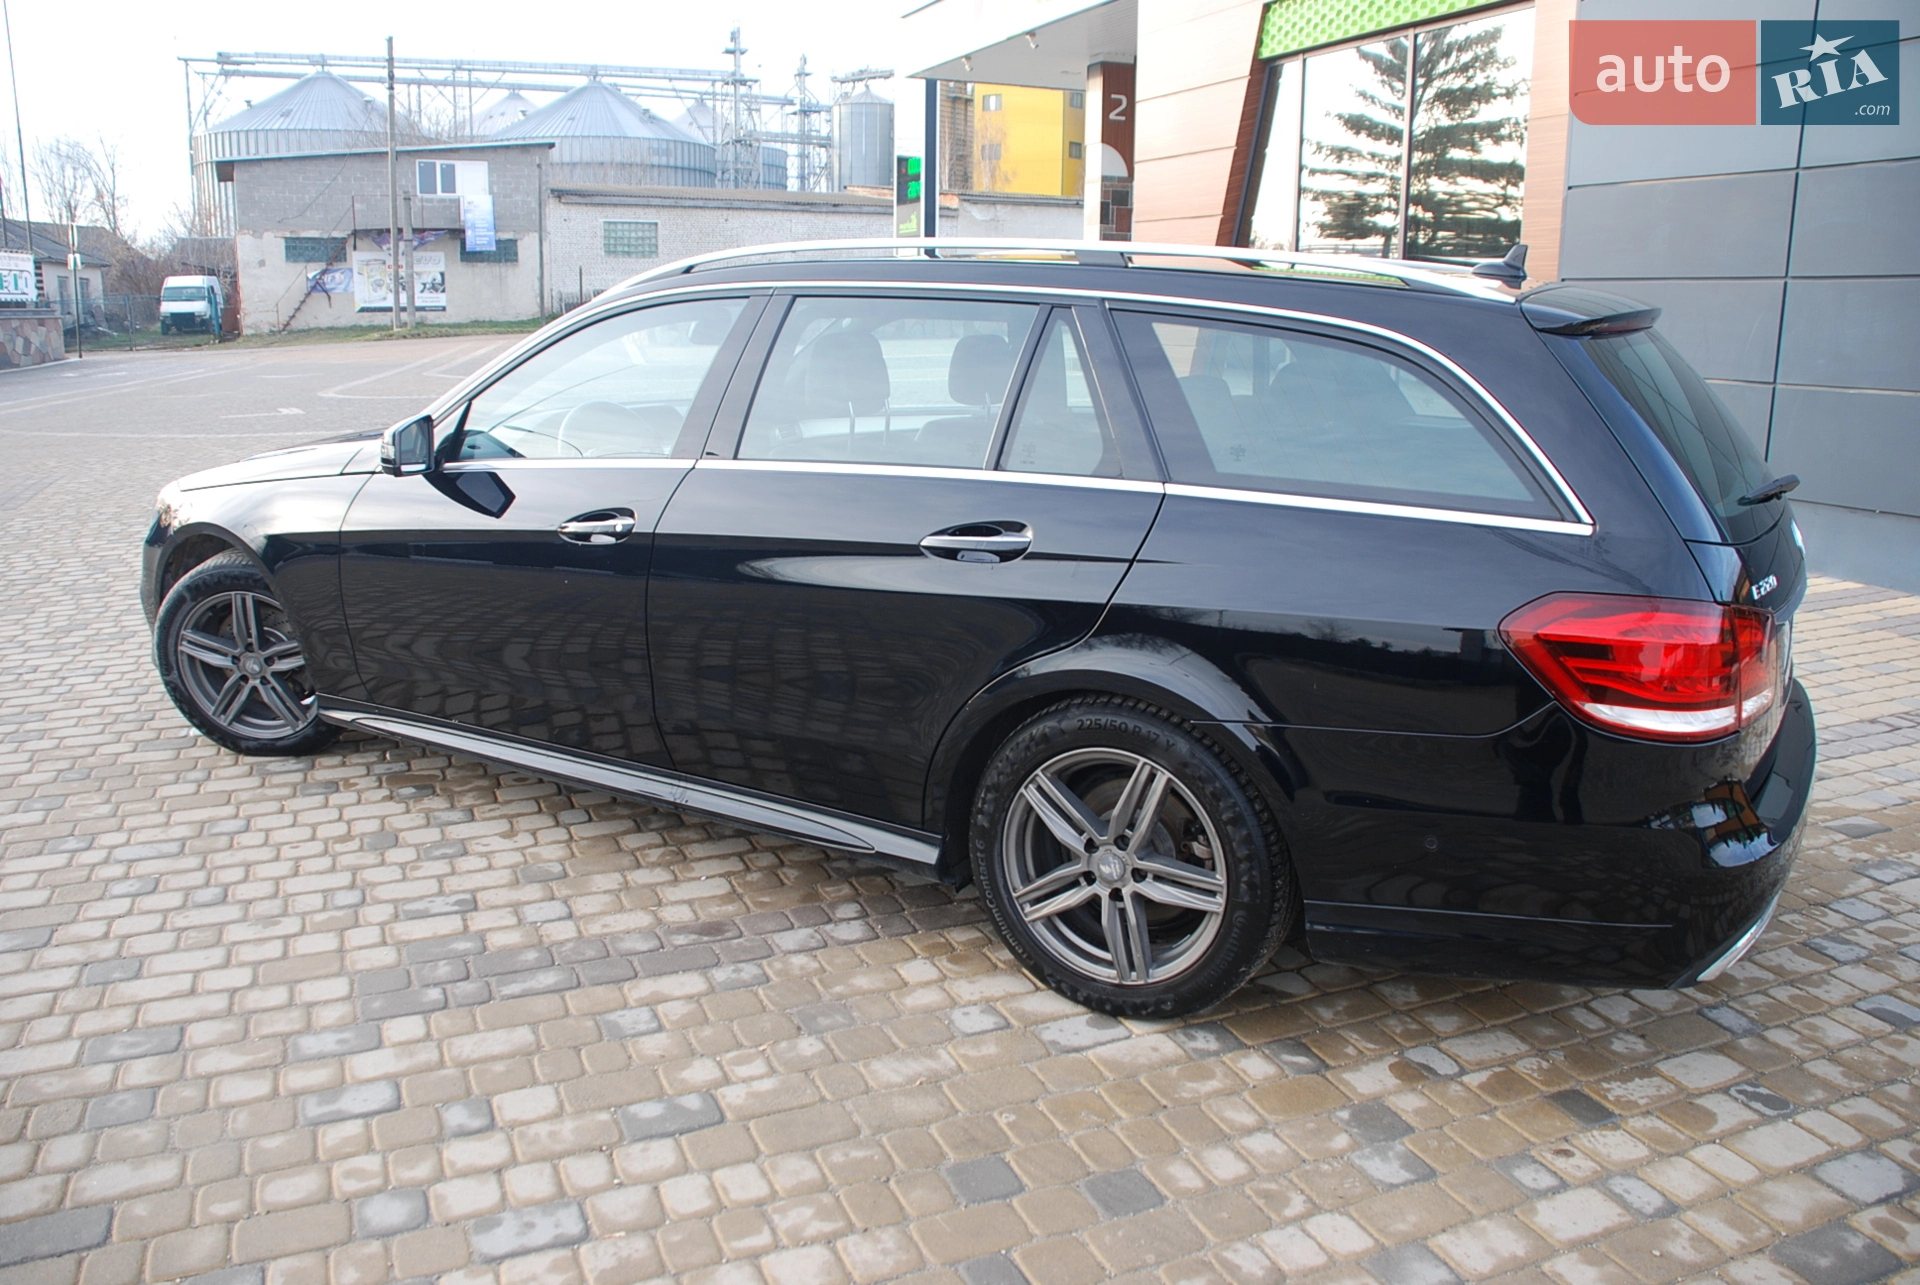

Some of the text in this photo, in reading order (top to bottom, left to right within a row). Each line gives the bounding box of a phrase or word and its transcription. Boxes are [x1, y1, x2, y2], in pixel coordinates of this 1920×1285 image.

[1109, 93, 1127, 120] 2
[1076, 717, 1129, 734] 225/50
[1131, 724, 1143, 738] R
